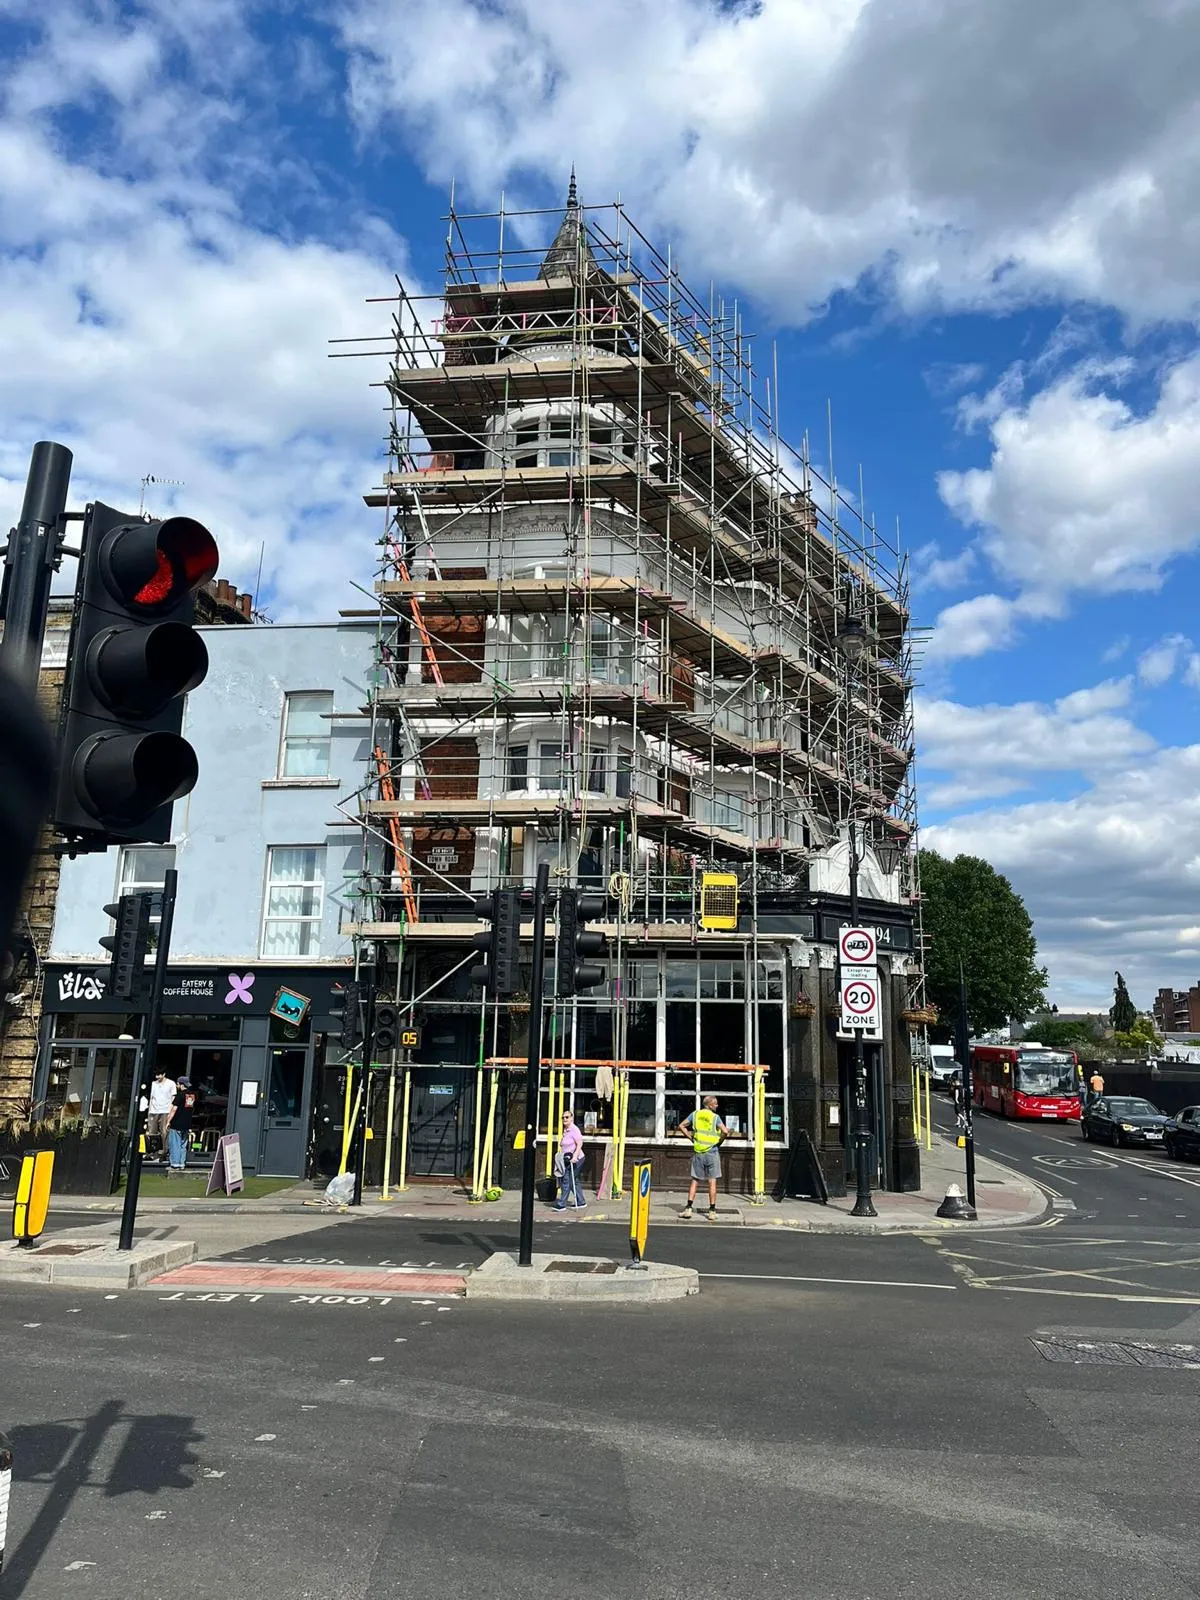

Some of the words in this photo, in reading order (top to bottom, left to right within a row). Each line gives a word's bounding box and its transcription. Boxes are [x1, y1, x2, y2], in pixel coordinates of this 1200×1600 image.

[181, 980, 207, 988] EATERY
[163, 988, 189, 996] COFFEE
[190, 988, 214, 996] HOUSE
[849, 991, 871, 1004] 20
[846, 1016, 875, 1025] ZONE
[402, 1032, 417, 1045] 05
[158, 1292, 265, 1303] LEFT
[290, 1295, 392, 1306] LOOK
